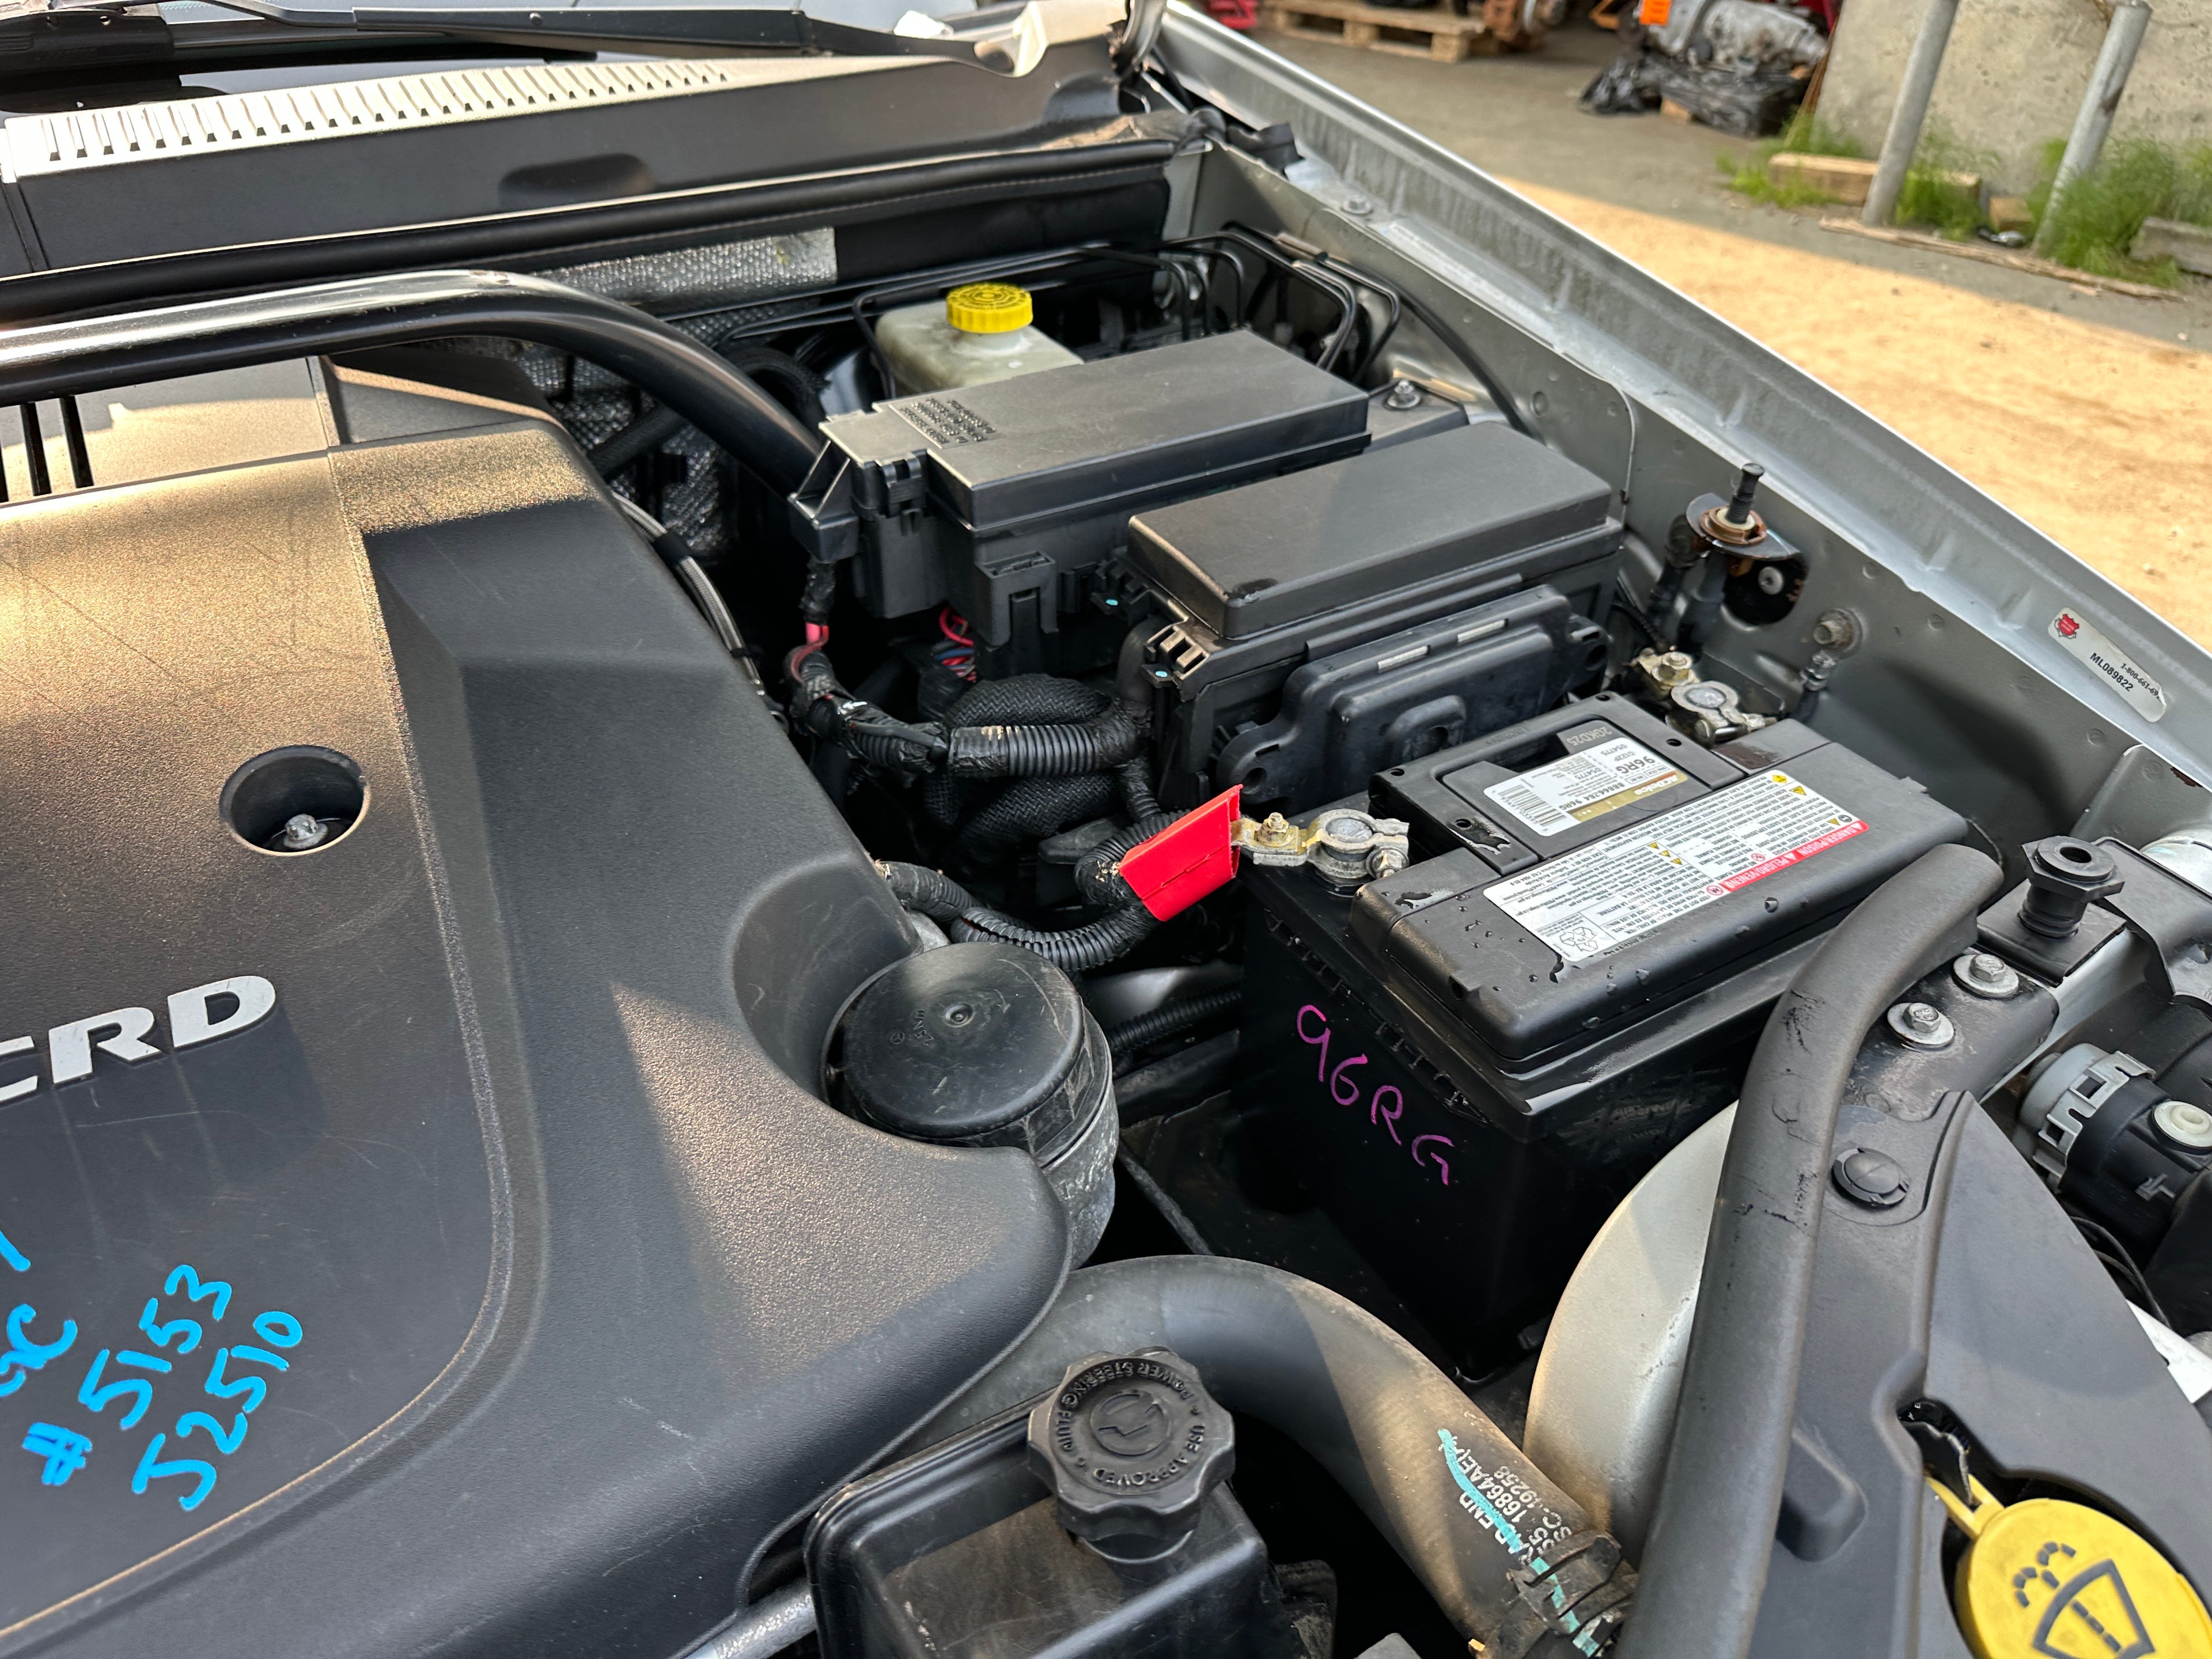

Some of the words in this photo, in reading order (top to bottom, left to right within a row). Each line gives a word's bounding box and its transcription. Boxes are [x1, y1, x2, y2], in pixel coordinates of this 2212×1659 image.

[2090, 652, 2134, 692] ML089822
[2120, 662, 2160, 700] 1-800-661-69
[1566, 726, 1612, 746] 2GKD25
[1599, 743, 1628, 756] 054775
[1573, 766, 1602, 780] 054775
[1613, 754, 1656, 775] 96RG
[1582, 781, 1625, 802] 88866284
[1632, 773, 1681, 797] ACDelco
[1558, 798, 1583, 810] 96RG
[1795, 825, 1858, 856] DANGER/POISON
[1722, 856, 1790, 889] PELIGRO/VENENO
[1297, 1004, 1455, 1185] 96RG
[1061, 1361, 1134, 1408] STEERING
[1137, 1362, 1194, 1401] POWER
[1055, 1410, 1074, 1452] FLUID
[1186, 1425, 1205, 1452] USE
[1094, 1452, 1189, 1486] APPROVED
